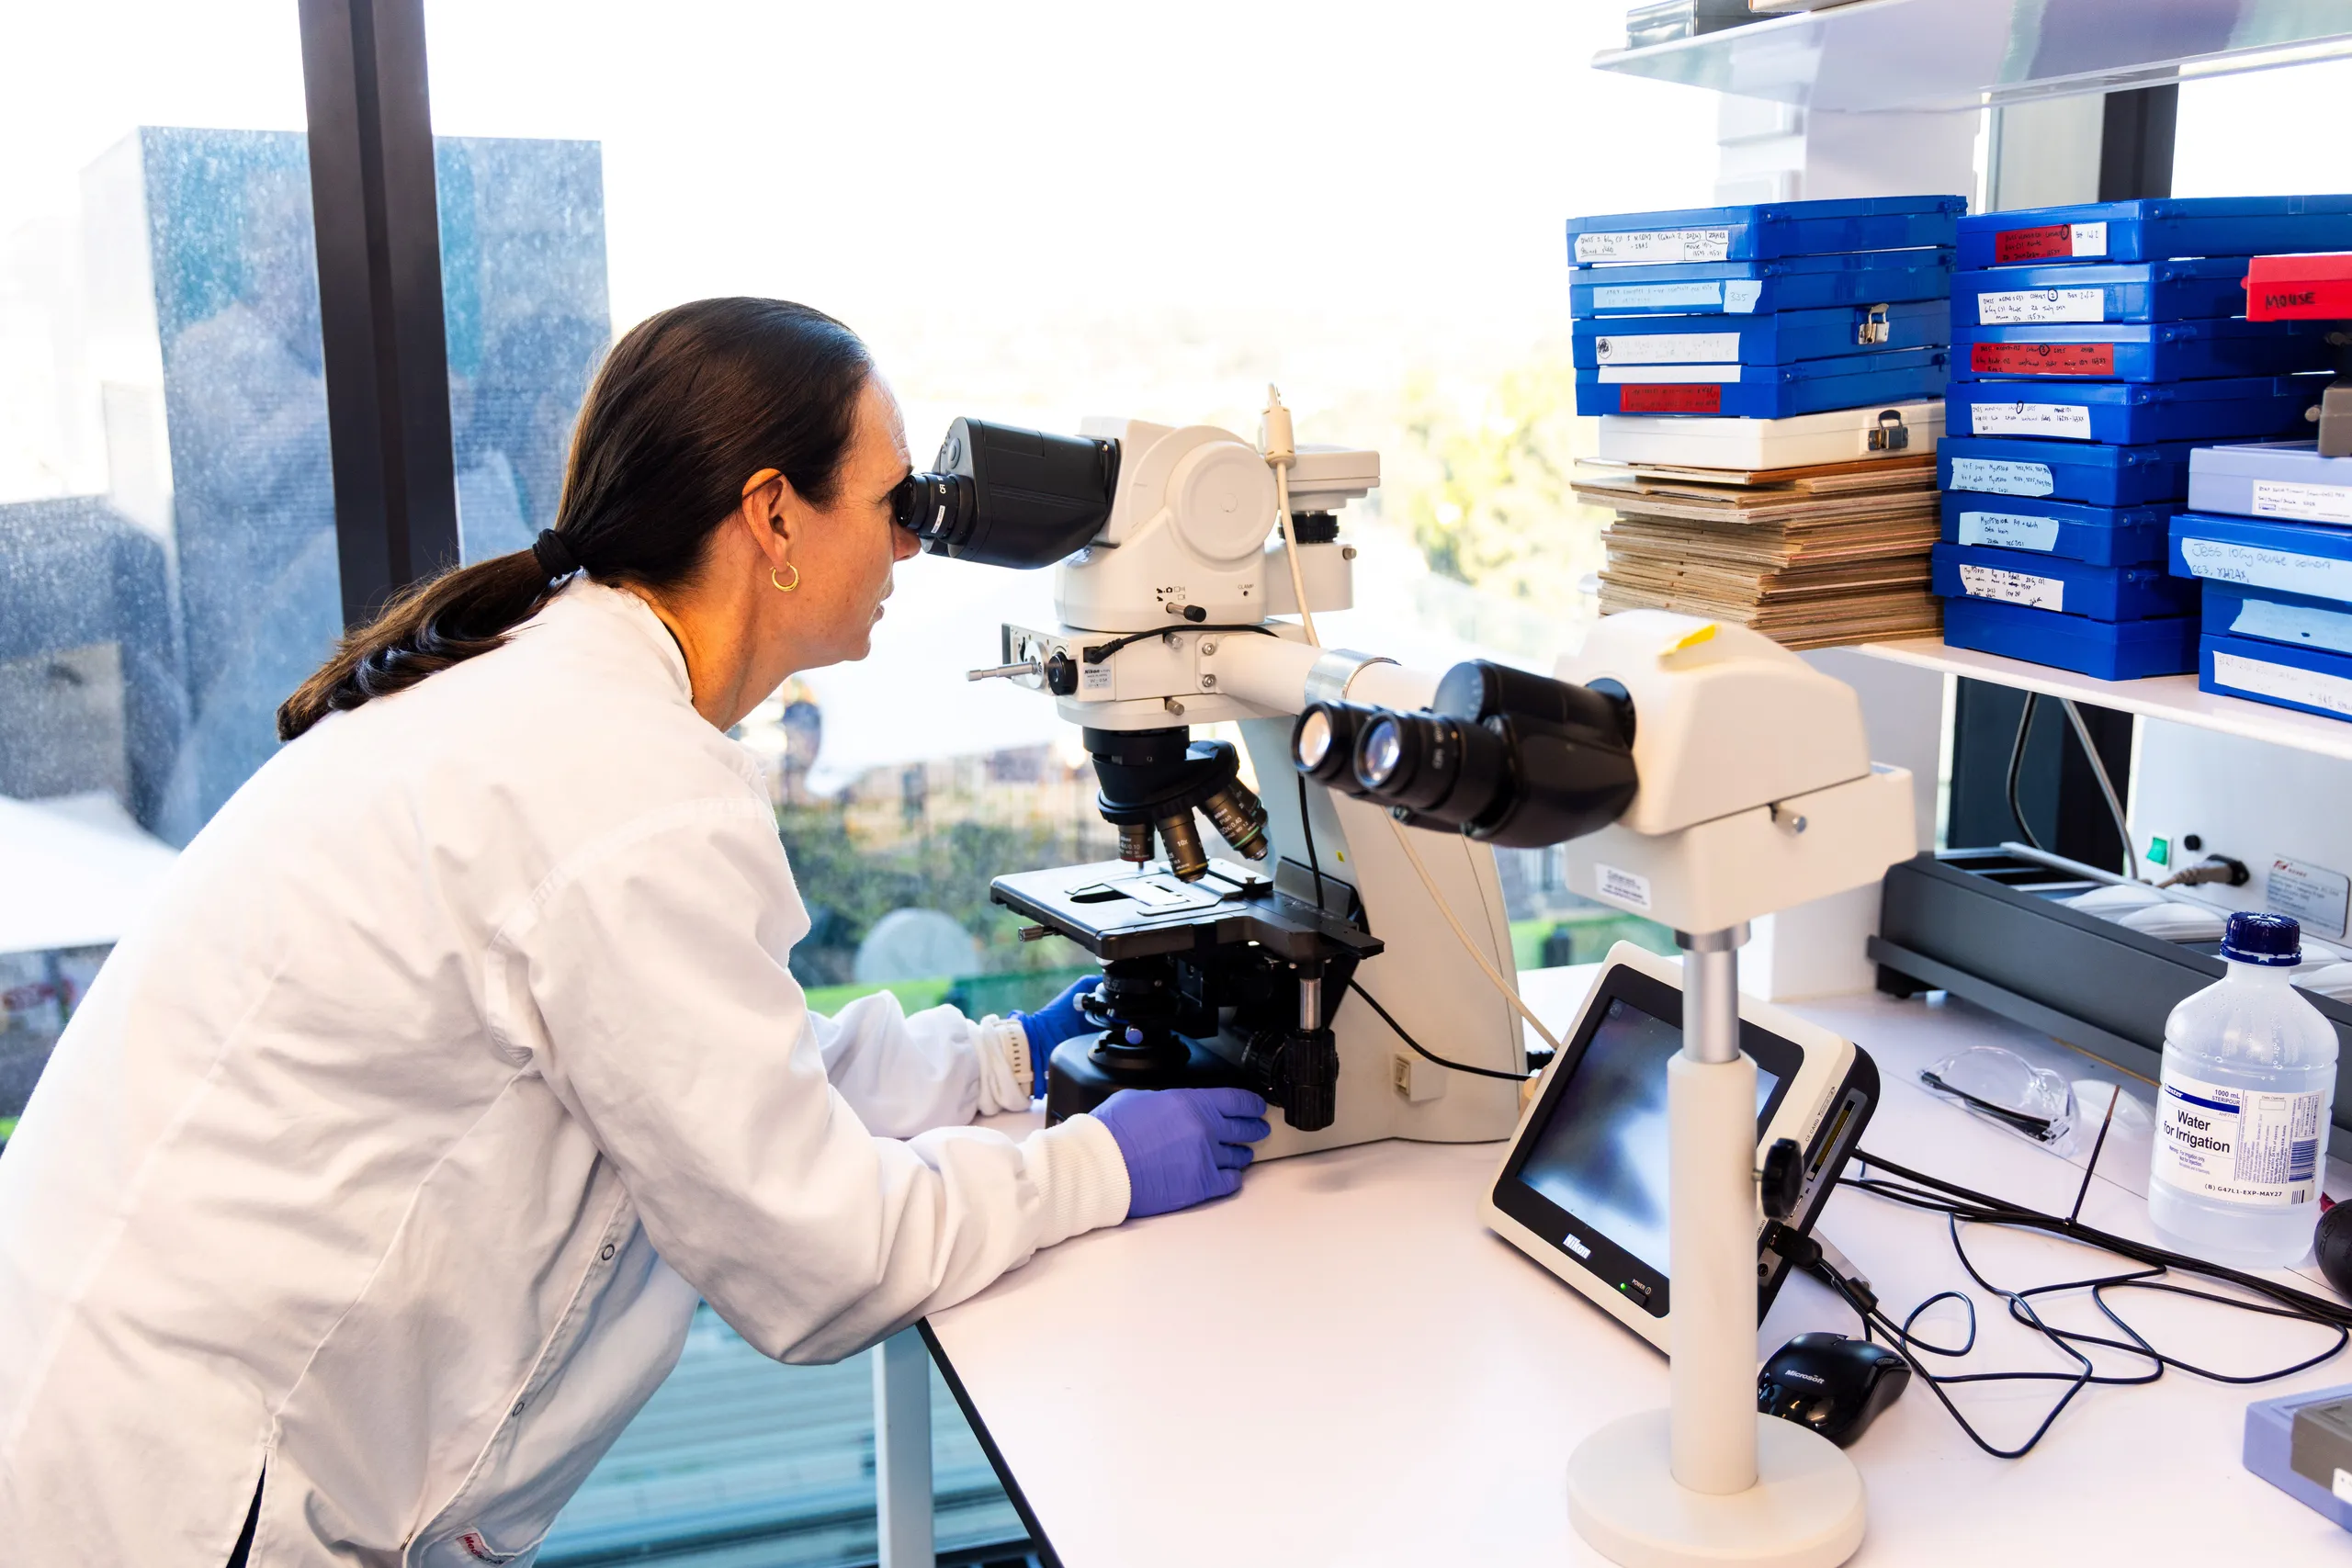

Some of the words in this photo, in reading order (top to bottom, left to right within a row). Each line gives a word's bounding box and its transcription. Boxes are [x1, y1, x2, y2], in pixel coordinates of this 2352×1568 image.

[1730, 291, 1748, 302] 335
[2266, 291, 2316, 311] MOUSE
[2191, 543, 2222, 558] Jess
[2256, 552, 2287, 566] acute
[1218, 815, 1232, 826] Plan
[1176, 839, 1189, 847] 10x
[2211, 1095, 2241, 1105] STERIPOUR
[2214, 1089, 2229, 1098] 1000
[1809, 1118, 1820, 1134] CARD
[2177, 1109, 2211, 1132] Water
[2163, 1120, 2175, 1136] for
[2176, 1126, 2231, 1154] Irrigation
[2217, 1186, 2282, 1197] G47L1-EXP-MAY27
[1562, 1233, 1591, 1259] Nikon
[1631, 1278, 1646, 1291] POWER
[1784, 1369, 1825, 1384] Microsoft
